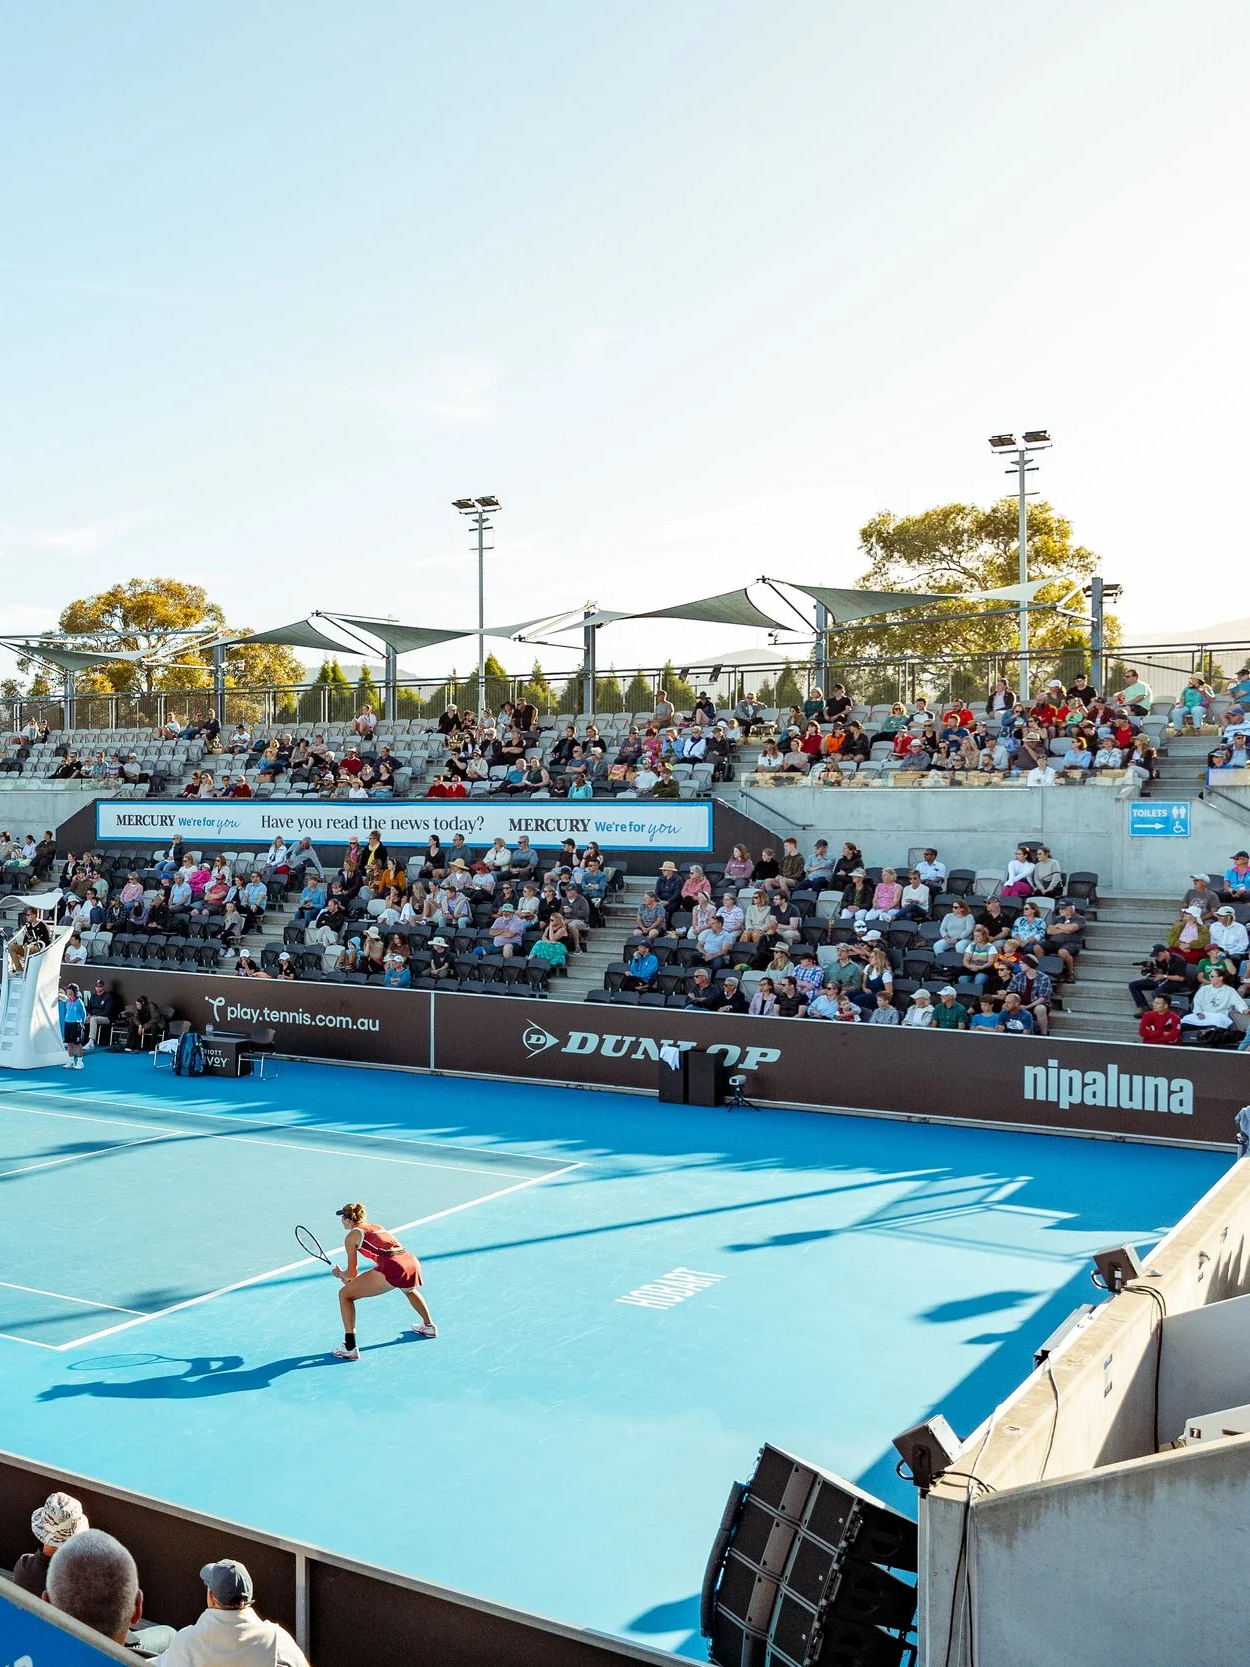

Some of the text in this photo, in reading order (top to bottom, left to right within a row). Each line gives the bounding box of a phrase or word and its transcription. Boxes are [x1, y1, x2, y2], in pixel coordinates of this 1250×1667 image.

[116, 814, 241, 834] MERCURY We're for you
[261, 815, 484, 834] Have you read the news today?
[1132, 809, 1167, 817] TOILETS
[508, 818, 682, 842] MERCURY We're for you
[226, 1002, 380, 1032] play.tennis.com.au
[1023, 1059, 1194, 1115] nipaluna
[614, 1266, 727, 1310] HOBART
